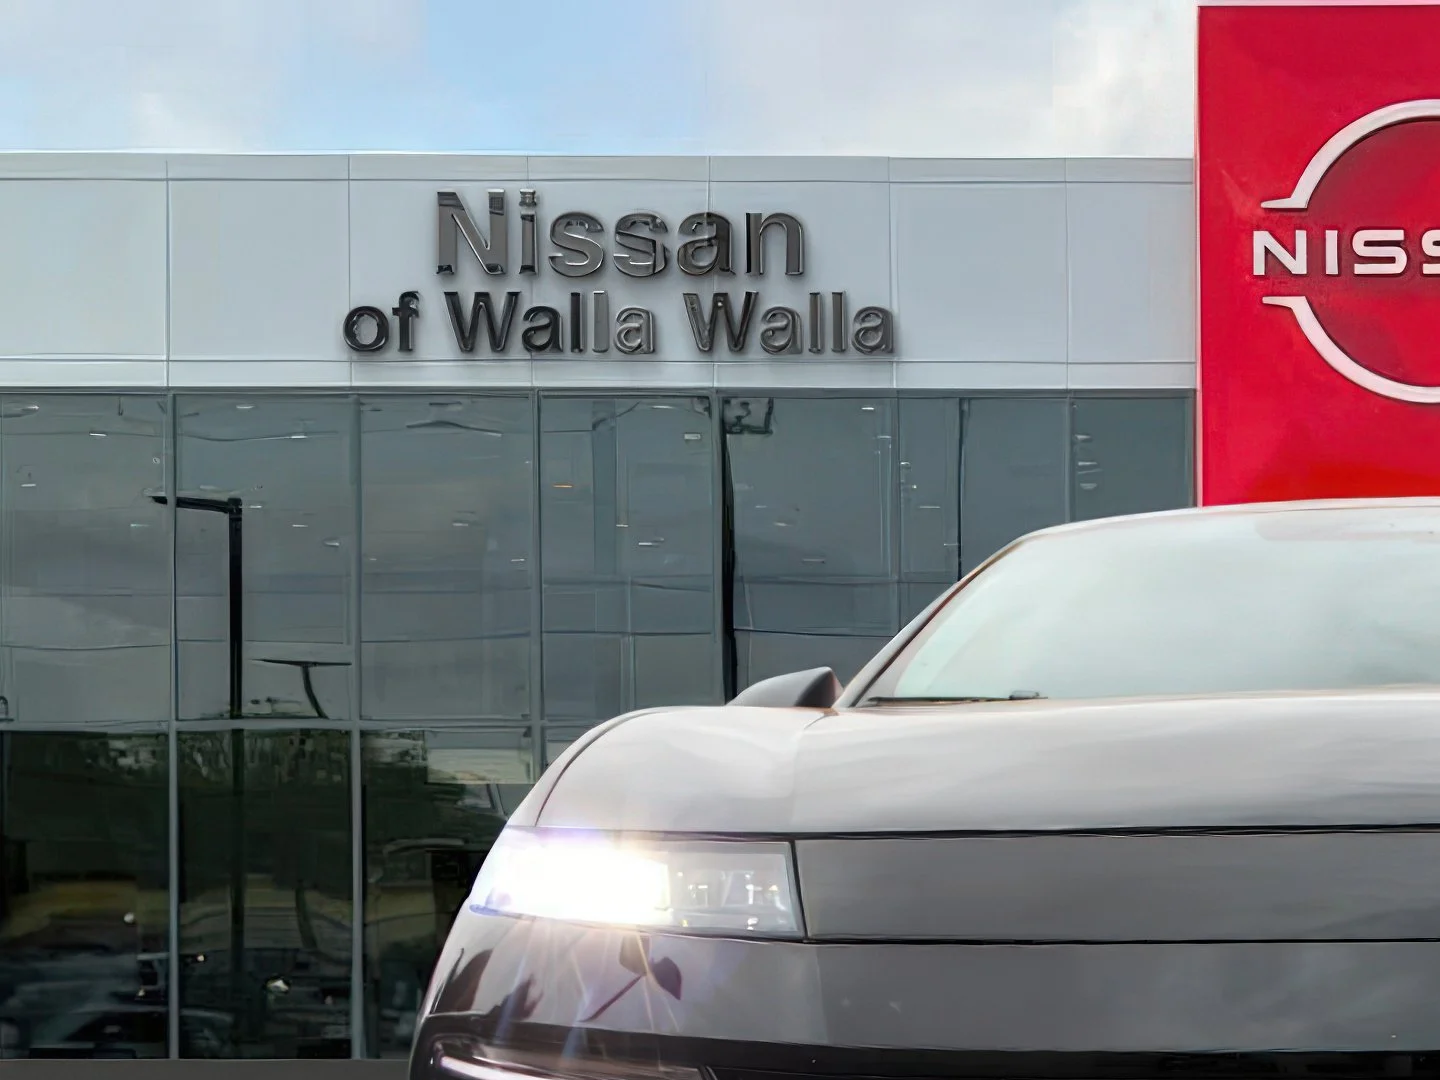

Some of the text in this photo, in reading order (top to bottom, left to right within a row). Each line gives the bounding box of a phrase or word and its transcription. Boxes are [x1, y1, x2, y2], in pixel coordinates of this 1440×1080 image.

[435, 188, 805, 278] Nissan
[342, 290, 894, 355] of Walla Walla
